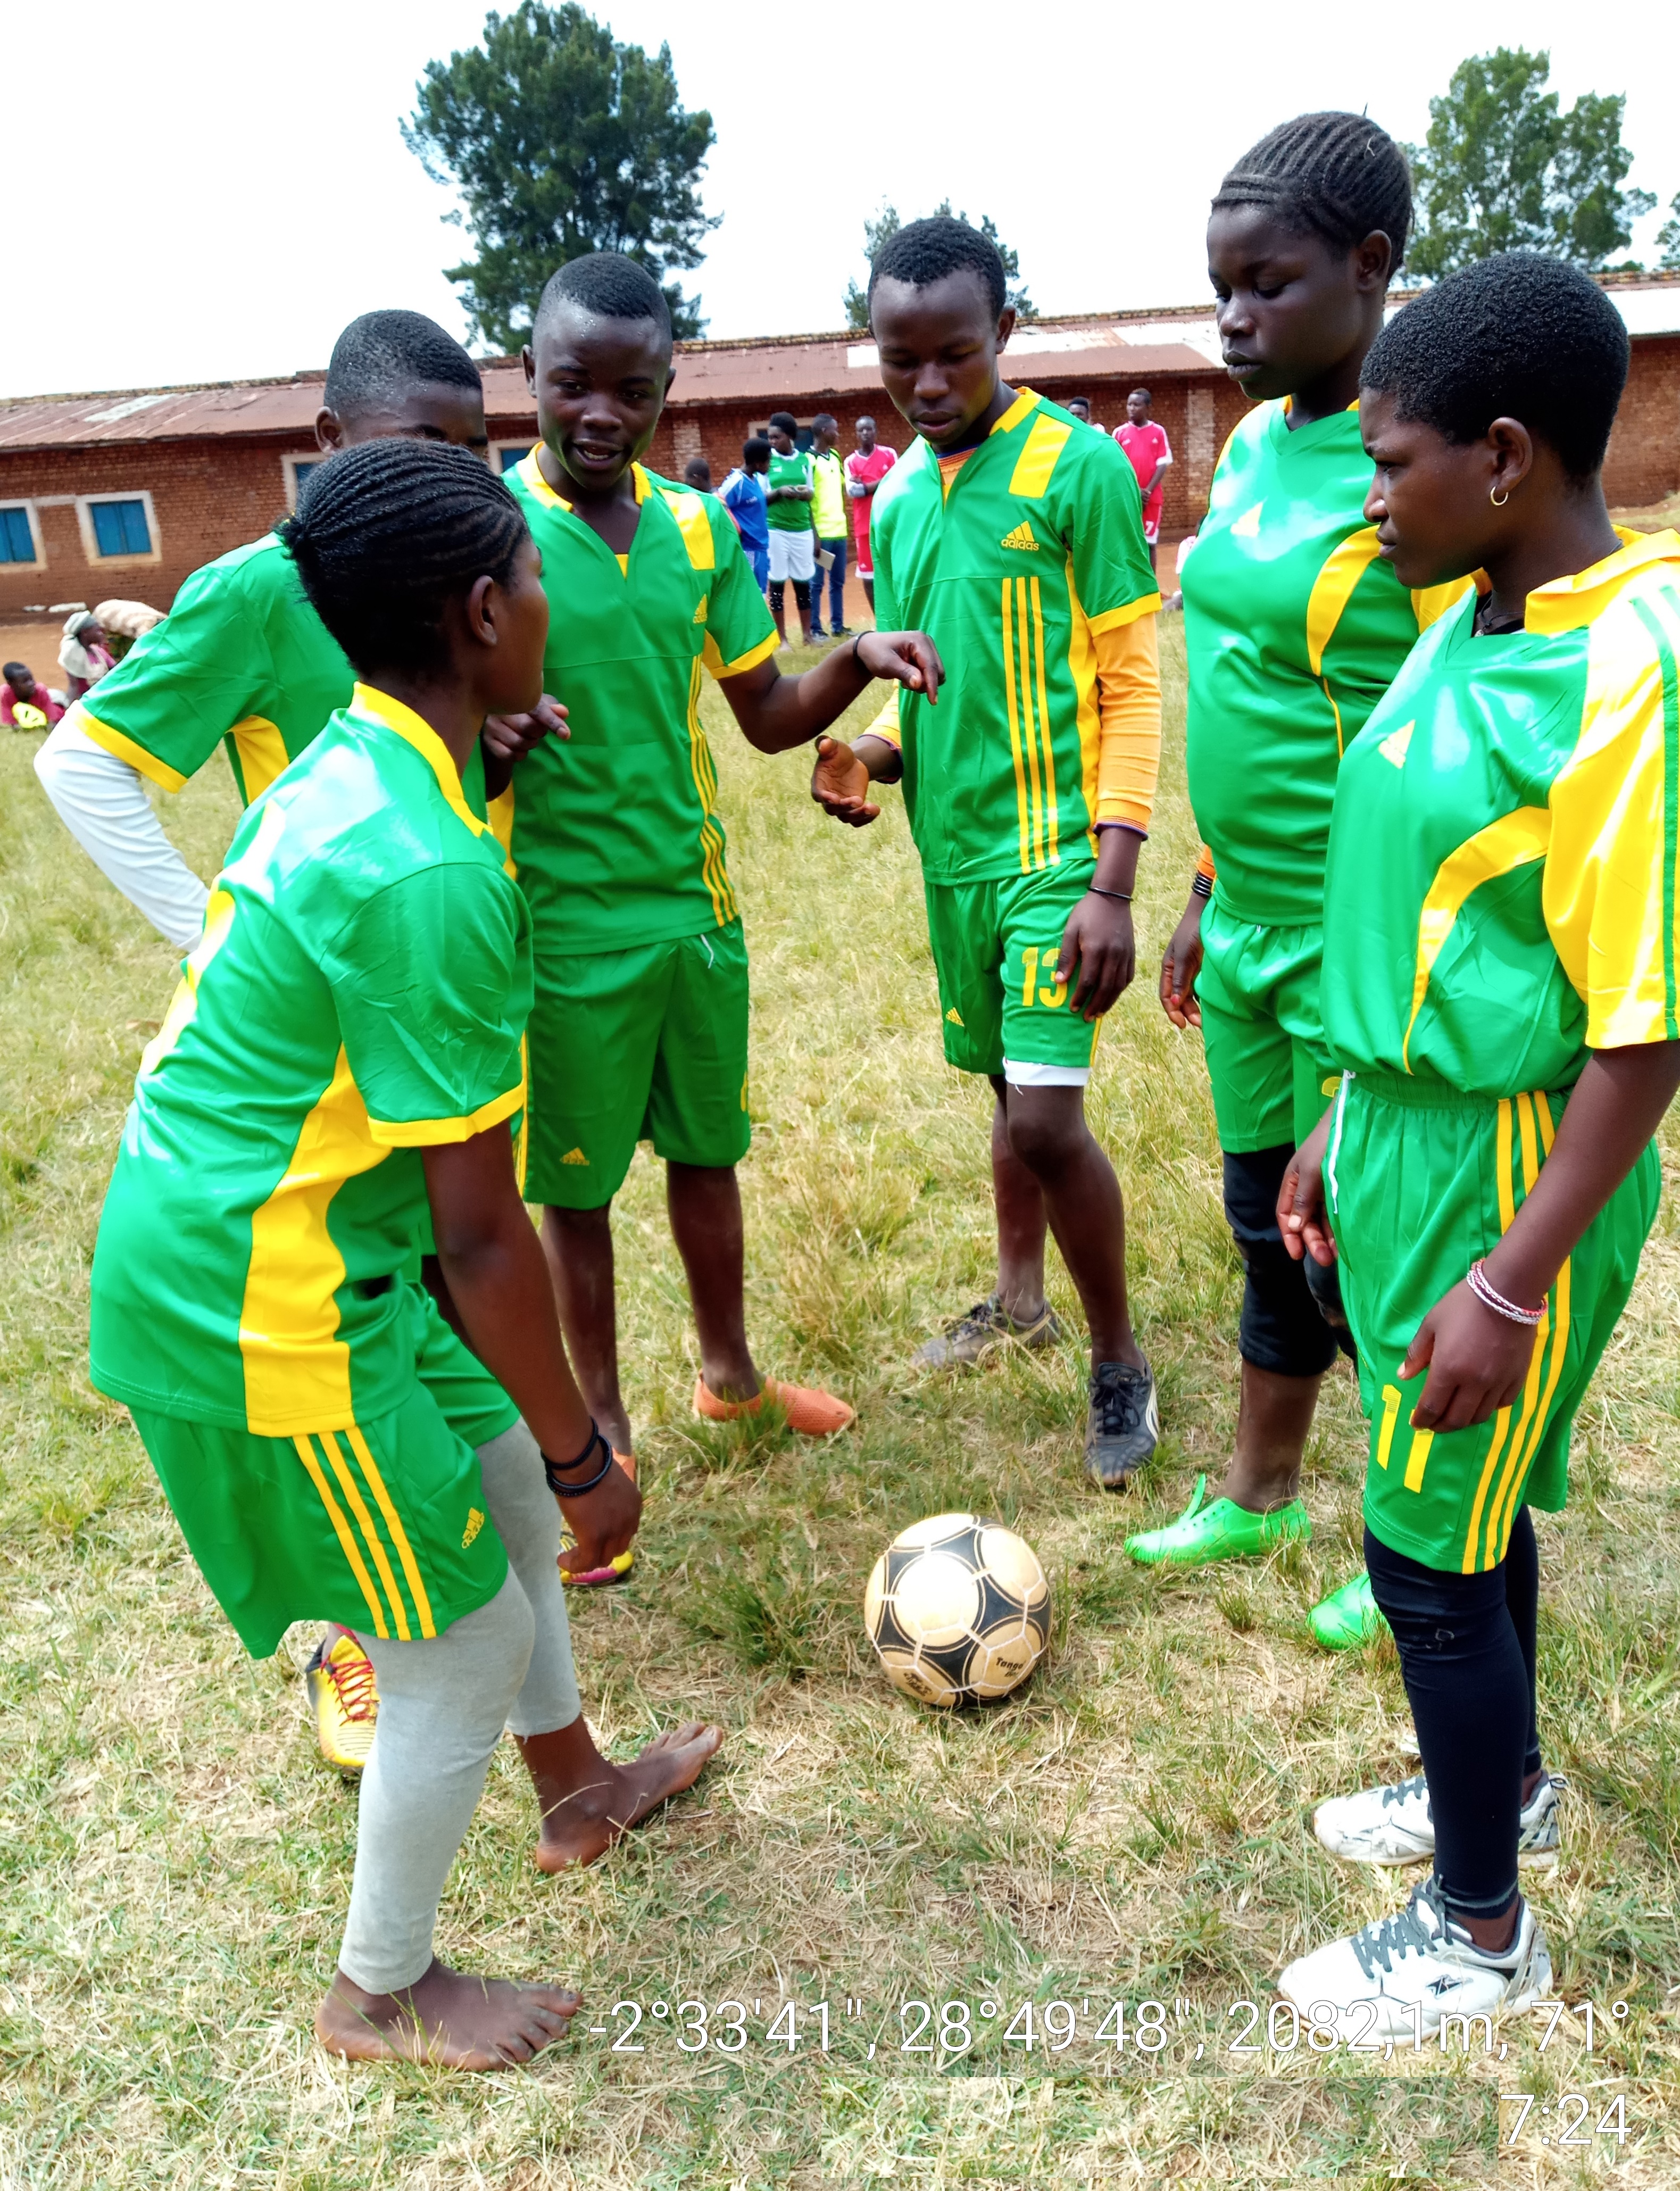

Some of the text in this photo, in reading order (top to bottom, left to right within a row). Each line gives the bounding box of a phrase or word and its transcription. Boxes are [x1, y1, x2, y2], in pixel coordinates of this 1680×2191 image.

[1001, 538, 1039, 551] adidas
[1021, 947, 1068, 1008] 13
[995, 1656, 1024, 1672] Tango
